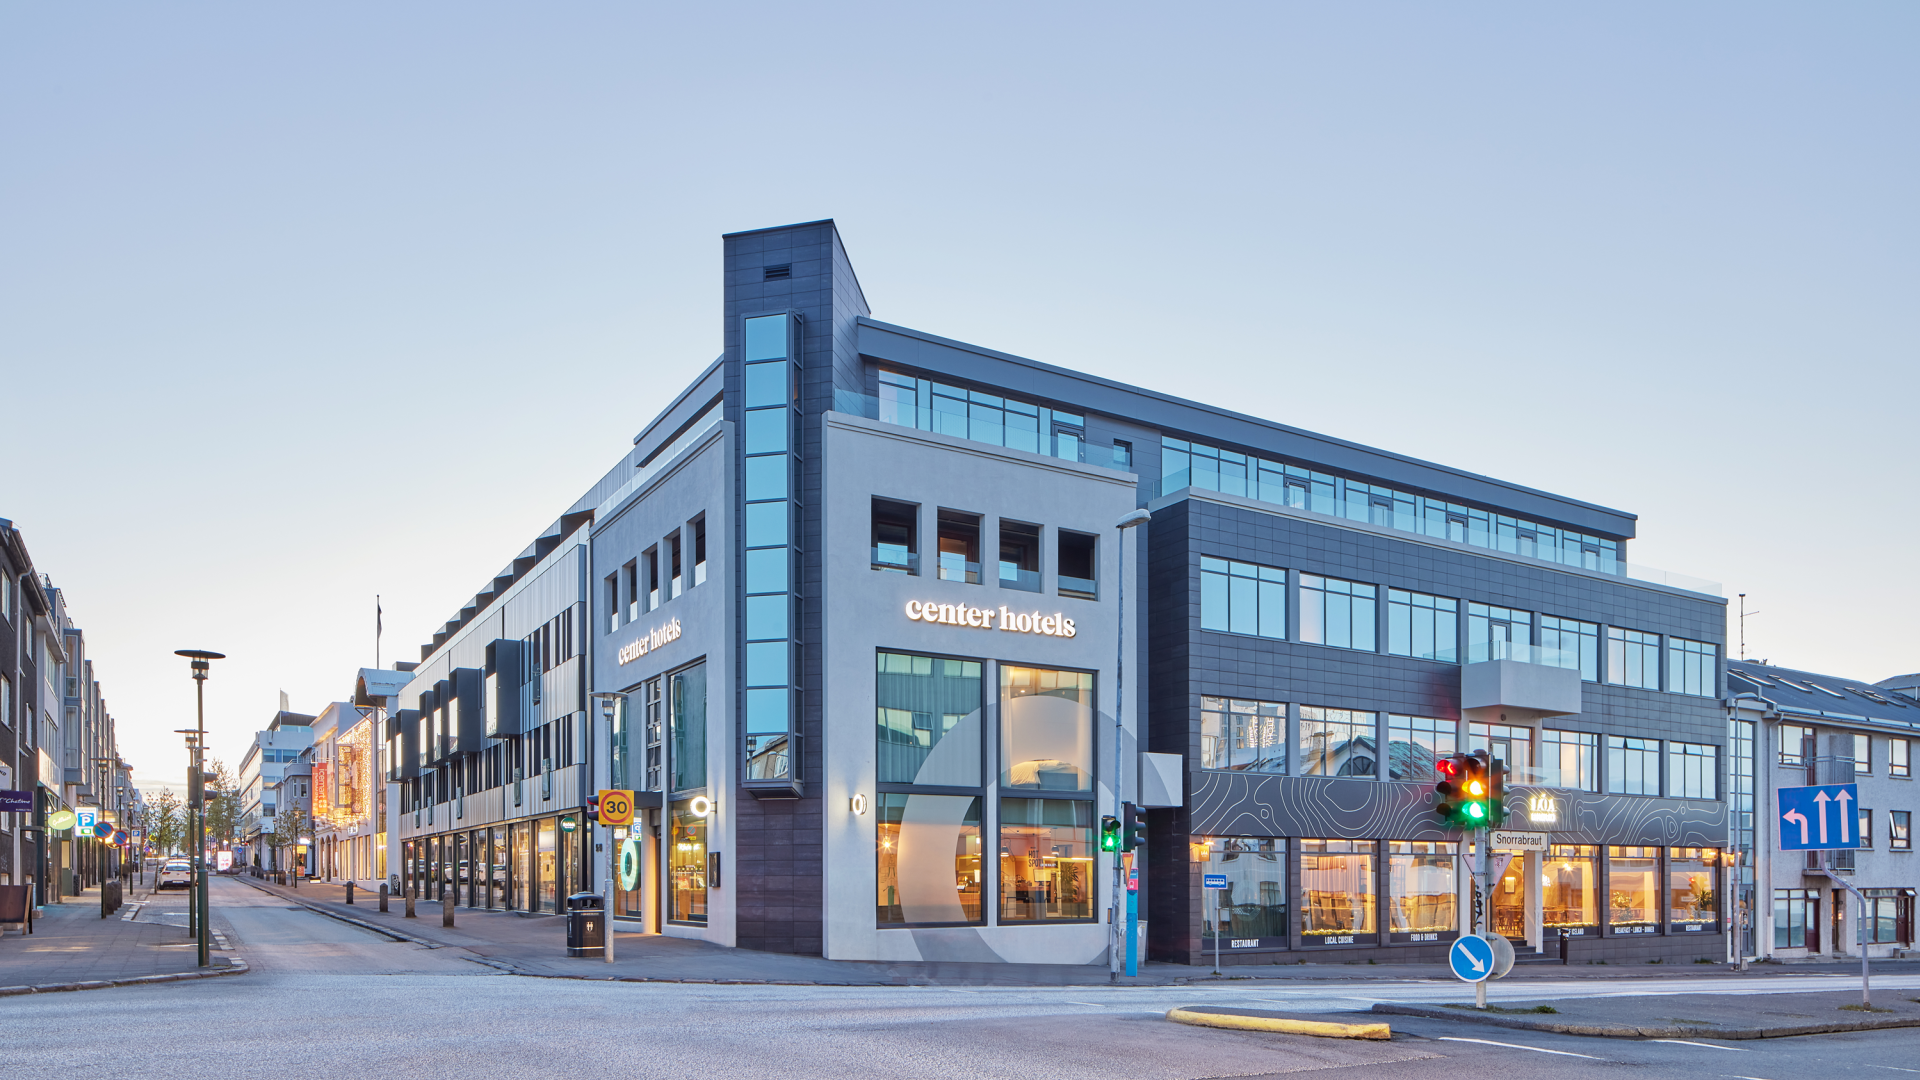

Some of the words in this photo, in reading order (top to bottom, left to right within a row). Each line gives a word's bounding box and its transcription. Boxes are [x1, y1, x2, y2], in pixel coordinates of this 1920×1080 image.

[905, 600, 996, 629] center
[998, 605, 1077, 638] hotels
[618, 636, 650, 666] center
[650, 616, 682, 651] hotels
[318, 768, 328, 798] icemart
[606, 801, 628, 814] 30
[81, 816, 91, 826] P
[1496, 833, 1542, 846] Snorrabraut
[1028, 850, 1039, 859] HOT
[1324, 936, 1338, 945] LOCAL
[1338, 935, 1354, 944] CUISINE
[1410, 933, 1420, 942] FOOD
[1424, 932, 1438, 941] DRINKS
[1231, 938, 1259, 949] RESTAURANT
